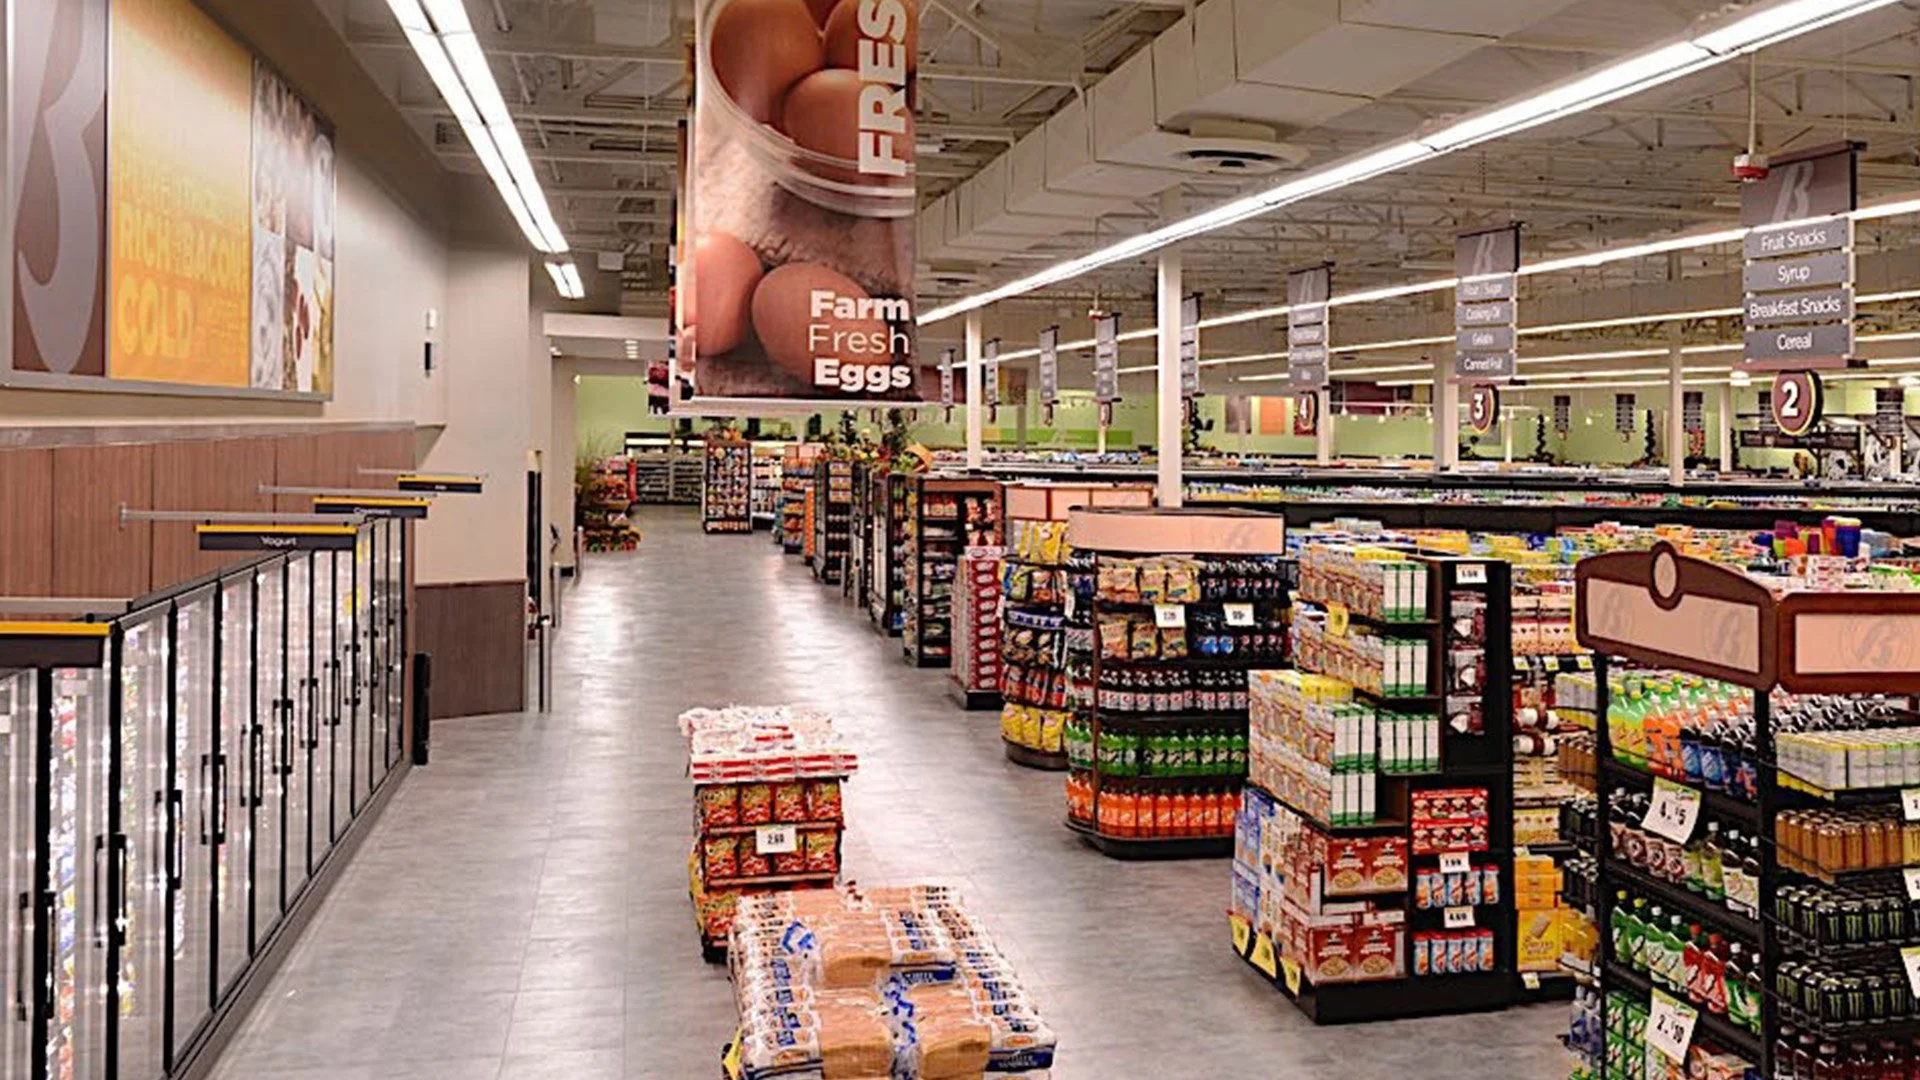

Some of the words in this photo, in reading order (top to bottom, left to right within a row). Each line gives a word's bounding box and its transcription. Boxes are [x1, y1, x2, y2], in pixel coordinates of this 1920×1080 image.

[119, 200, 171, 272] RICH
[1760, 234, 1785, 251] Fruit
[1787, 229, 1828, 247] Snacks
[1777, 264, 1811, 285] Syrup
[118, 273, 193, 360] COLD
[810, 290, 909, 322] Farm
[1749, 299, 1799, 320] Breakfast
[1800, 295, 1842, 316] Snacks
[808, 323, 909, 354] Fresh
[1776, 331, 1813, 351] Cereal
[814, 357, 912, 393] Eggs
[1473, 392, 1484, 420] 3
[1780, 380, 1799, 417] 2
[260, 535, 298, 547] Yogurt
